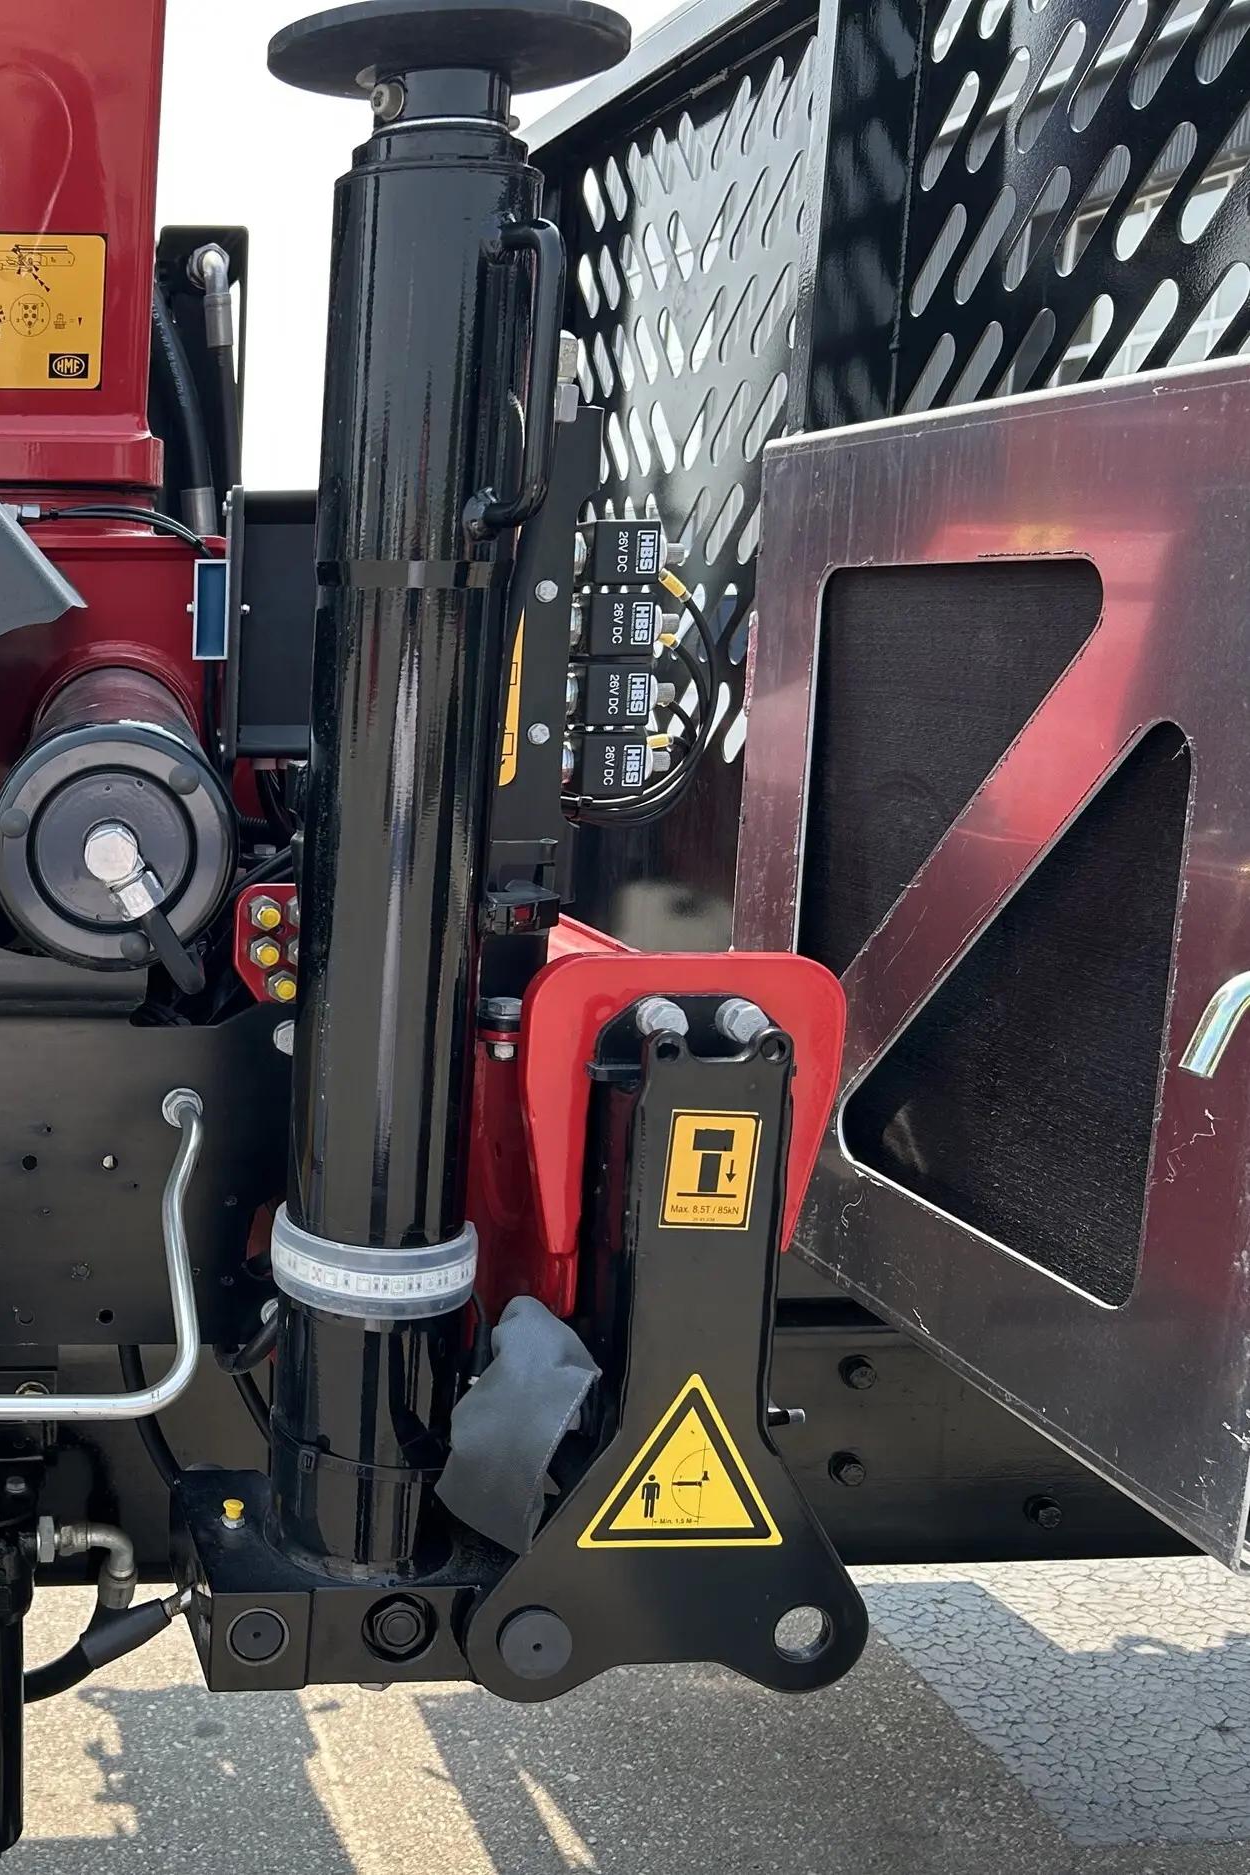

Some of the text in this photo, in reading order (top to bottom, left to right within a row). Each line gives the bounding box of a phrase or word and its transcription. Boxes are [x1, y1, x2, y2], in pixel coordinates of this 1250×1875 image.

[57, 358, 80, 374] HMF
[617, 531, 629, 572] 26V DC
[639, 534, 654, 570] HBS
[612, 603, 624, 643] 26V DC
[635, 606, 649, 641] HBS
[608, 674, 620, 715] 26V DC
[630, 677, 645, 712] HBS
[603, 746, 615, 785] 26V DC
[626, 749, 640, 783] HBS
[670, 1204, 689, 1213] Max.
[692, 1205, 710, 1214] 8,5T
[718, 1206, 739, 1214] 85kN
